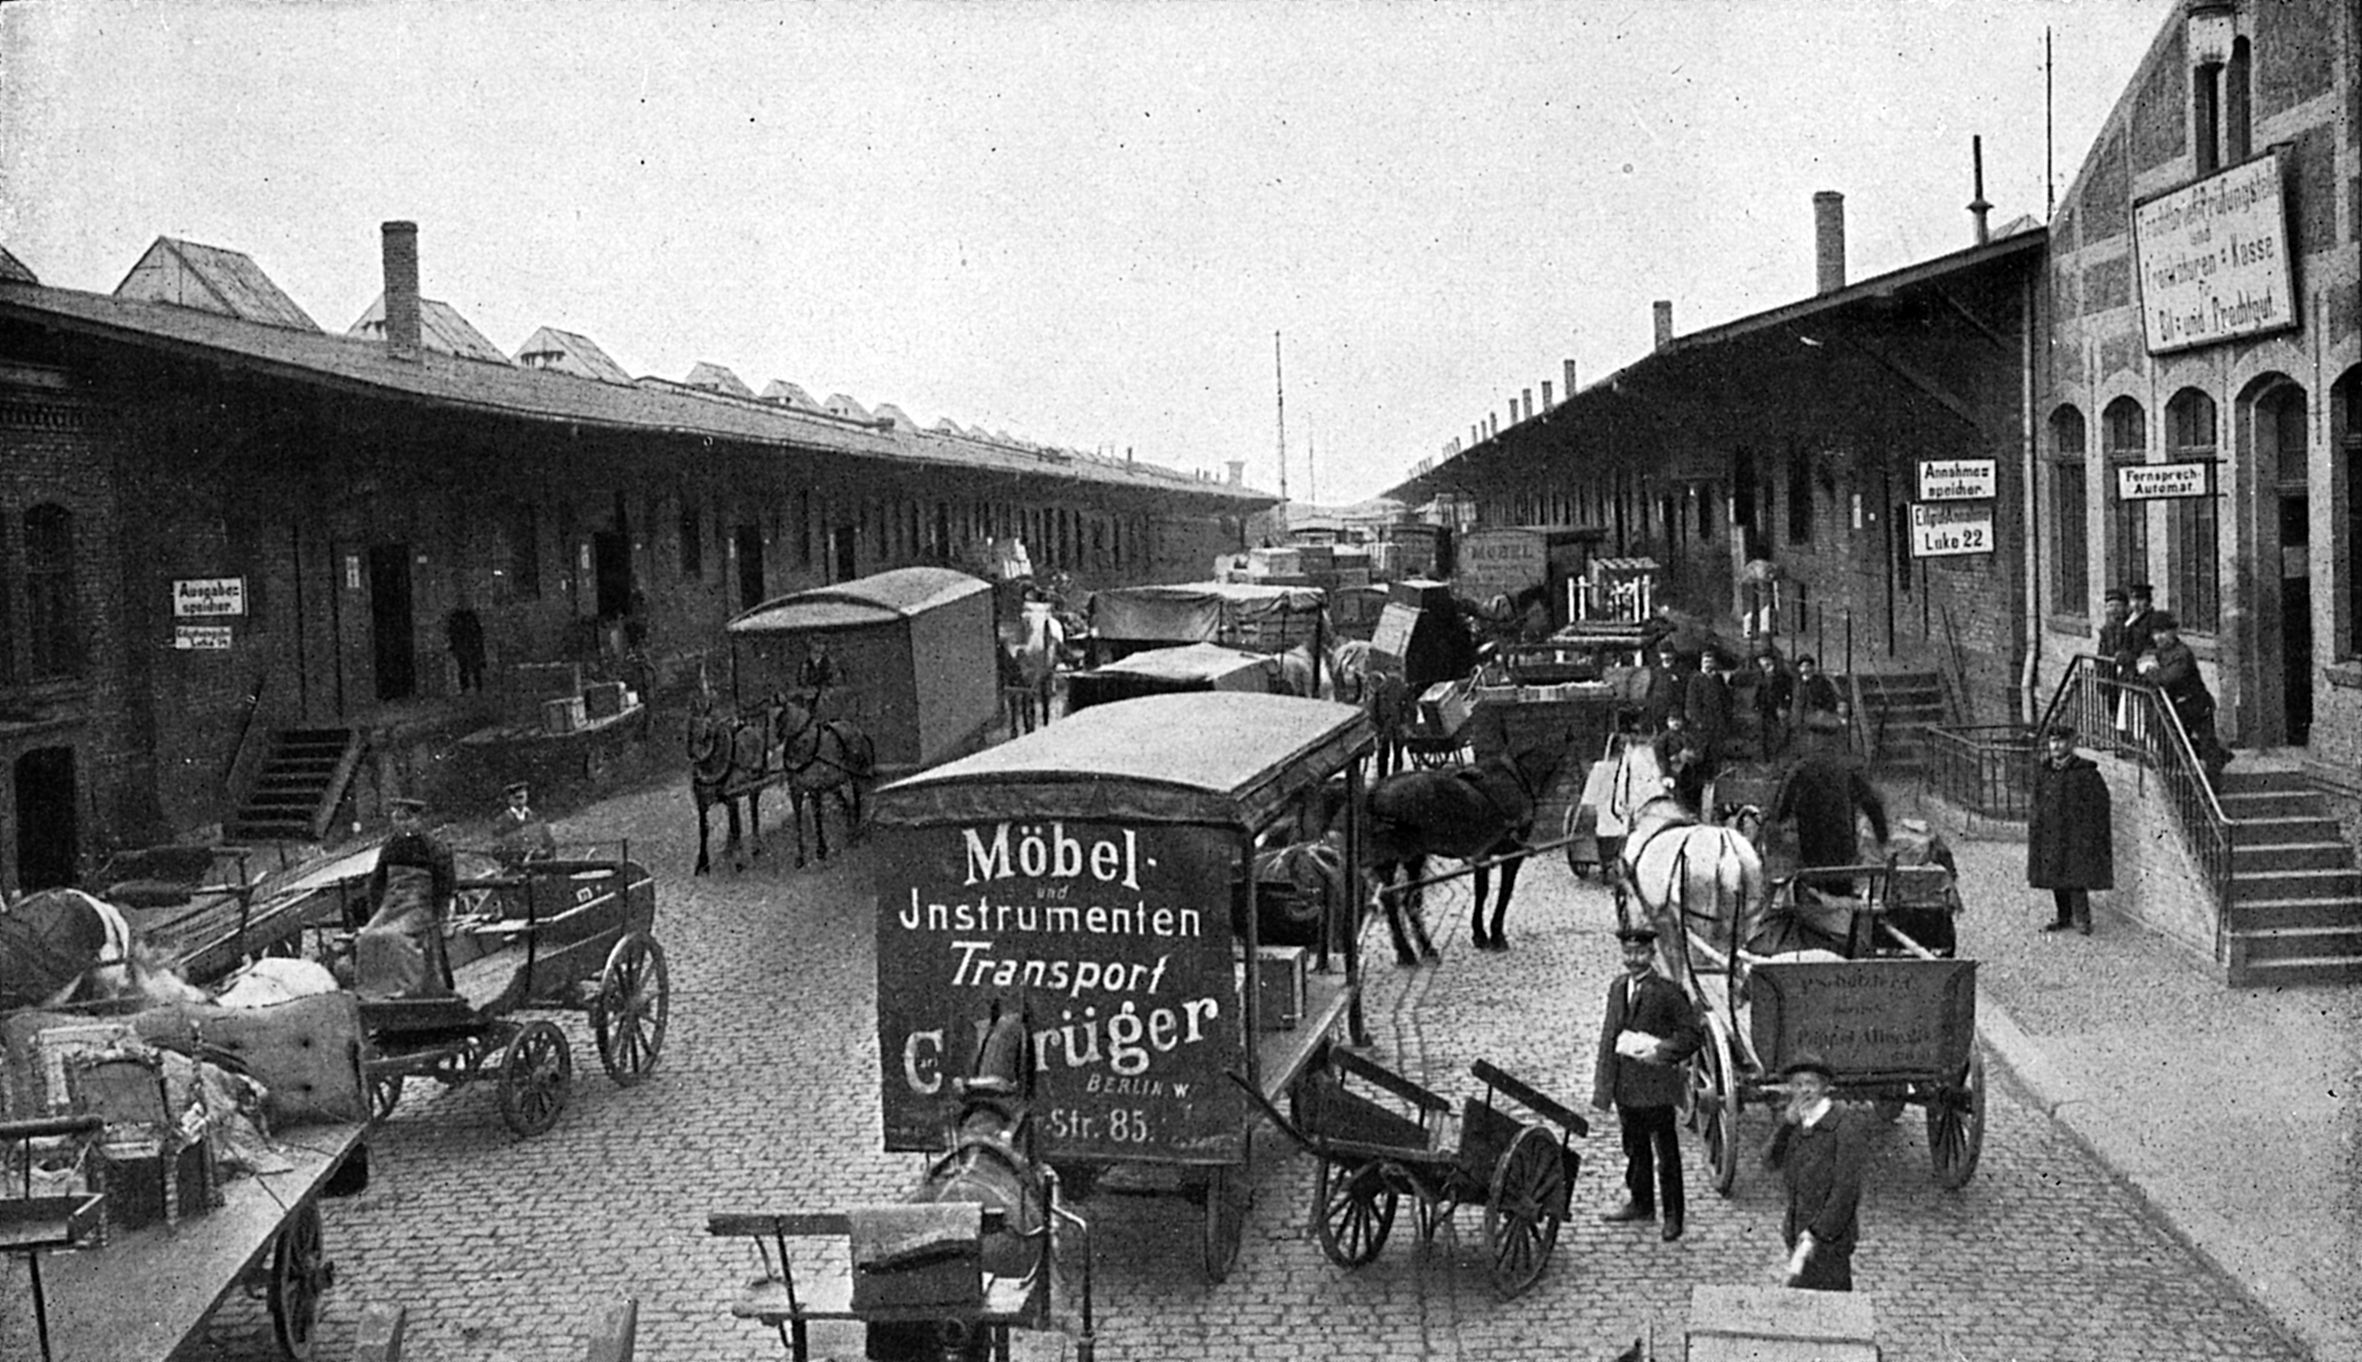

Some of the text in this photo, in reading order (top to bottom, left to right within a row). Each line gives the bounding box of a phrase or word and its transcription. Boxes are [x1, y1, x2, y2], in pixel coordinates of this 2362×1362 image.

[2230, 233, 2274, 268] Kasse
[1925, 529, 1983, 550] Luke 22
[1036, 885, 1069, 899] und
[950, 940, 1171, 998] Transport
[974, 997, 1219, 1076] rüger
[1086, 1073, 1163, 1097] BERLIN
